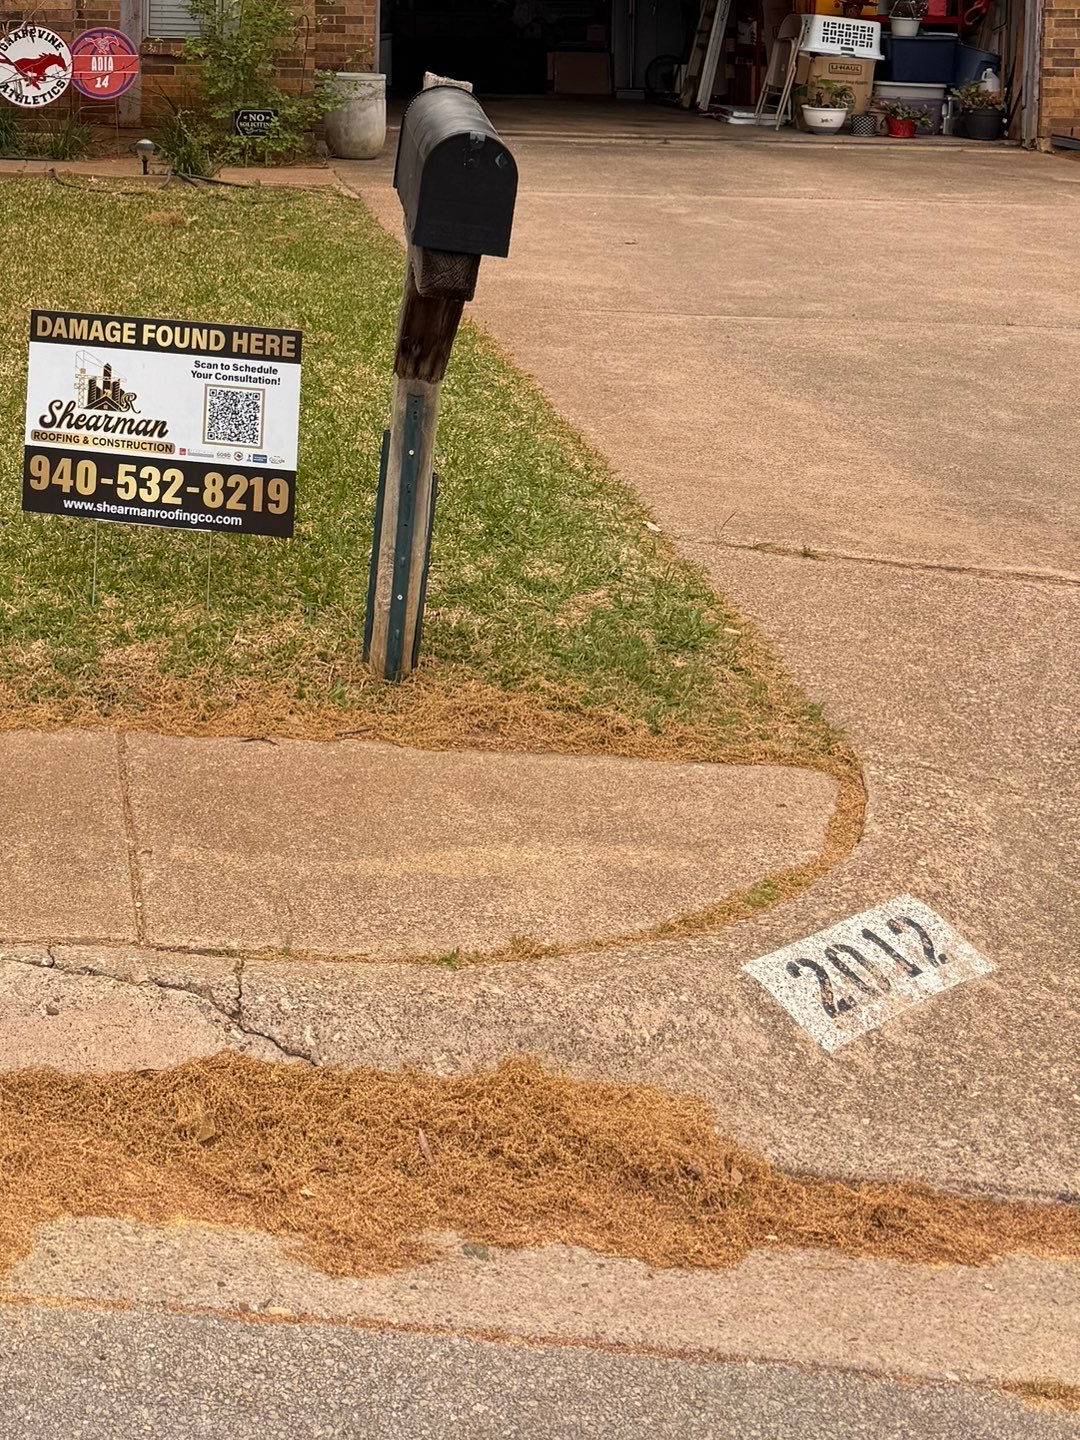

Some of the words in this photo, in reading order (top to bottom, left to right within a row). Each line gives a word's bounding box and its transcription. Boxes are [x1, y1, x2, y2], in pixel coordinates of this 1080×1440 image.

[0, 79, 66, 105] ATHLETICS
[94, 74, 110, 88] 14
[239, 121, 271, 129] SOLICITIN
[248, 113, 265, 122] NO
[35, 315, 137, 345] DAMAGE
[142, 324, 226, 352] FOUND
[231, 333, 297, 358] HERE
[191, 370, 213, 379] Your
[214, 372, 281, 386] Consultation!
[193, 360, 218, 370] Scan
[220, 362, 230, 371] to
[232, 363, 279, 375] Schedule
[38, 399, 169, 438] Shearman
[33, 431, 80, 444] ROOFING
[82, 436, 89, 445] &
[92, 437, 173, 453] CONSTRUCTION
[28, 454, 290, 516] 940-532-8219
[62, 497, 243, 526] www.shearmanroofingco.com
[785, 915, 949, 1019] 2012
